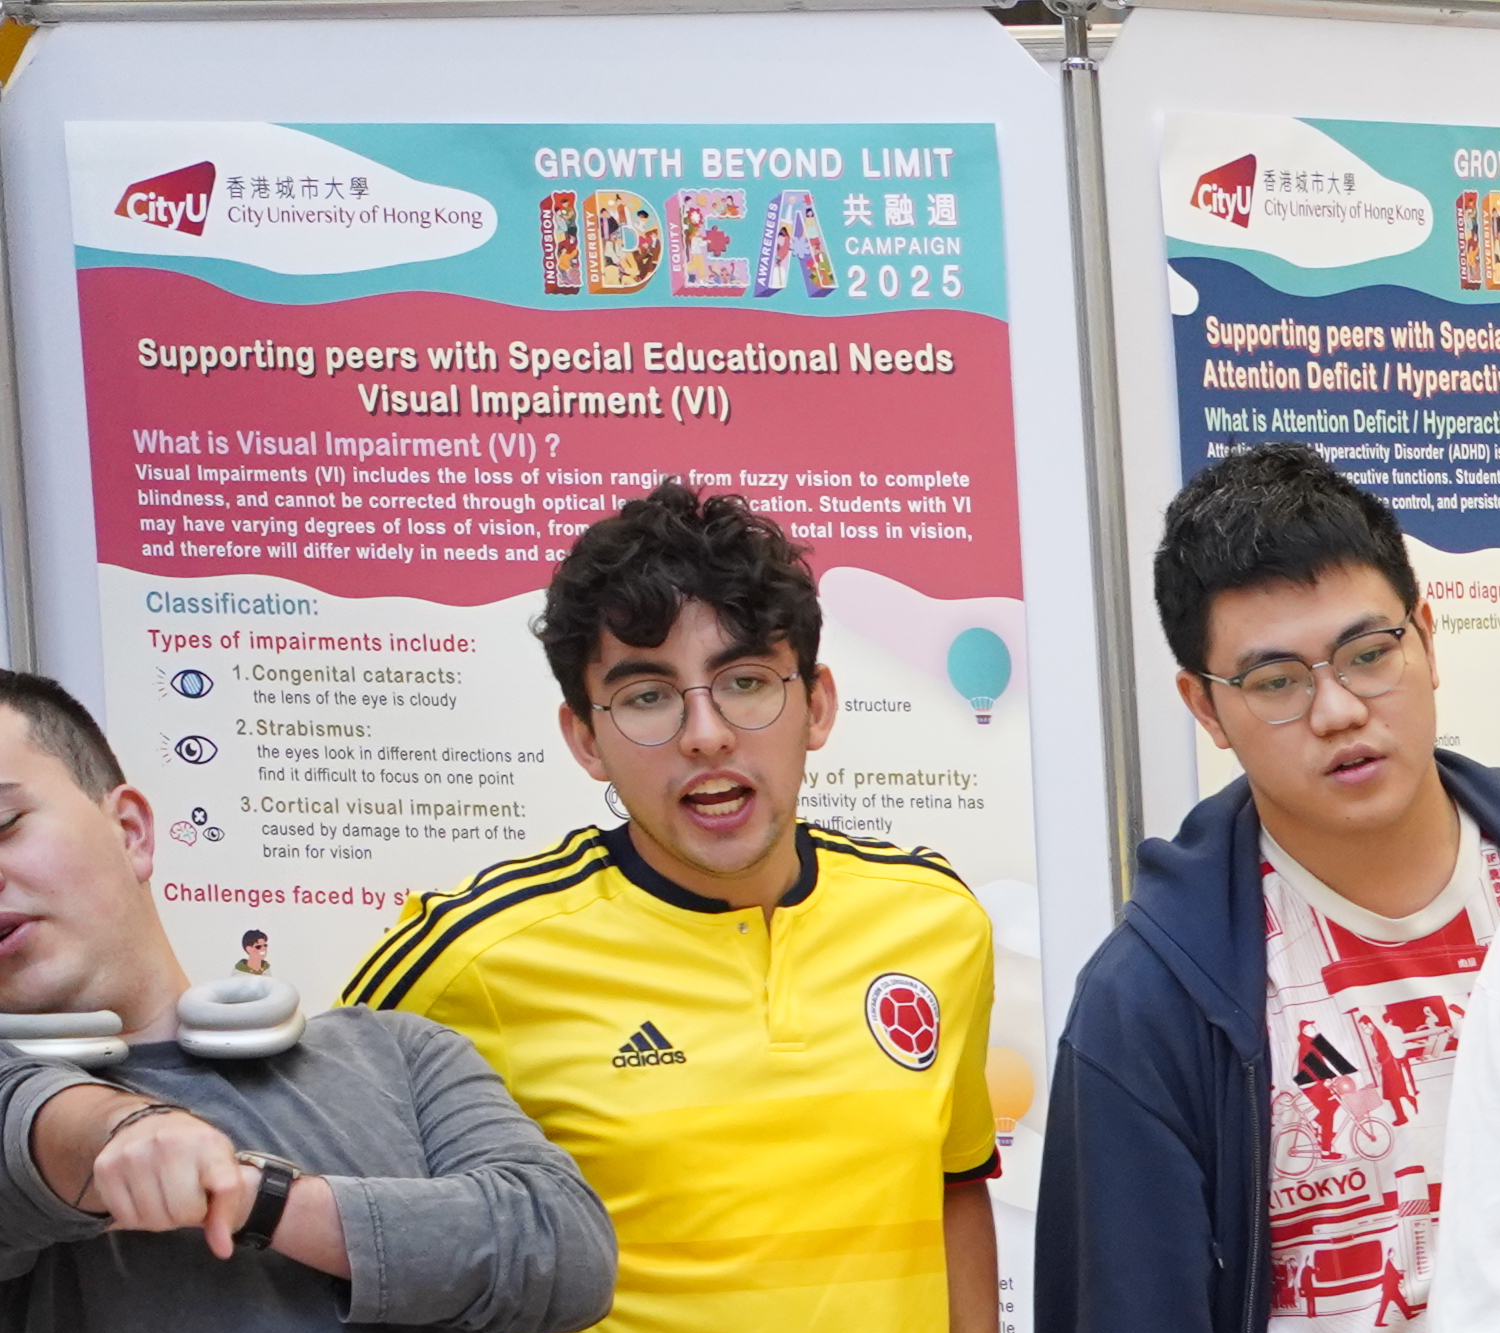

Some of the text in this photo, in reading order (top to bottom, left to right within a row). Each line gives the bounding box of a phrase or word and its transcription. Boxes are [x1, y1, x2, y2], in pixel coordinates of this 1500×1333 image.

[534, 147, 954, 179] GROWTH BEYOND LIMIT
[226, 176, 370, 200] 香港城市大學
[1263, 170, 1357, 195] 香港城市大學
[126, 192, 208, 231] CityU
[843, 193, 958, 228] 共融週
[1198, 183, 1254, 218] CityU
[228, 206, 483, 229] City University of Hong Kong
[544, 208, 555, 285] INCLUSION
[588, 210, 600, 283] DIVERSITY
[670, 221, 682, 273] EQUITY
[757, 202, 779, 286] AWARENESS
[845, 237, 961, 256] CAMPAIGN
[847, 264, 964, 298] 2025
[138, 338, 954, 377] Supporting peers with Special Educational Needs
[1203, 360, 1300, 391] Attention
[1306, 364, 1377, 393] Deficit
[358, 384, 730, 423] Visual Impairment (VI)
[146, 591, 319, 617] Classification:
[1426, 582, 1464, 601] ADHD
[148, 629, 477, 655] Types of impairments include:
[253, 690, 457, 710] the lens of the eye is cloudy
[845, 698, 912, 713] structure
[612, 1047, 687, 1069] adidas
